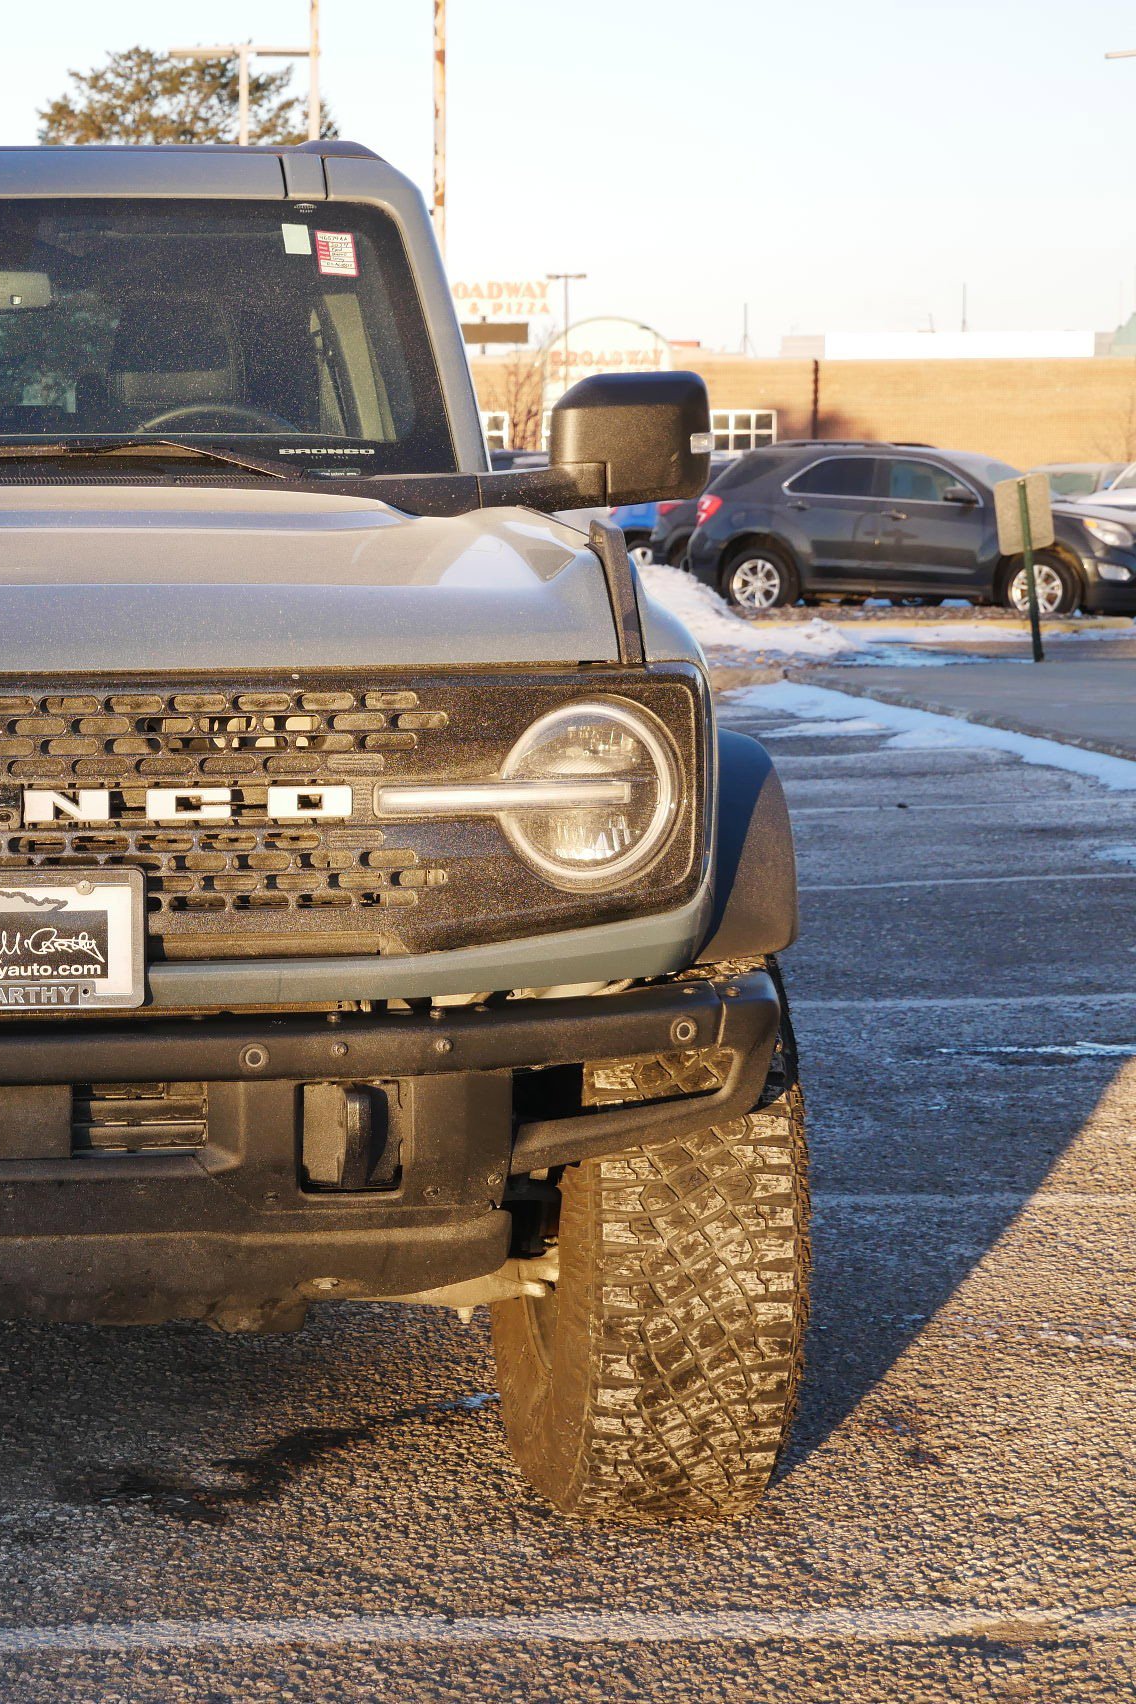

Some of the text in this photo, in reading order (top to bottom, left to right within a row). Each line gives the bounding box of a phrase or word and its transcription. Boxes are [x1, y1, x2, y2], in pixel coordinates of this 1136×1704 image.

[452, 280, 550, 299] OADWAY
[492, 302, 550, 315] PIZZA
[550, 349, 664, 367] BROADWAY
